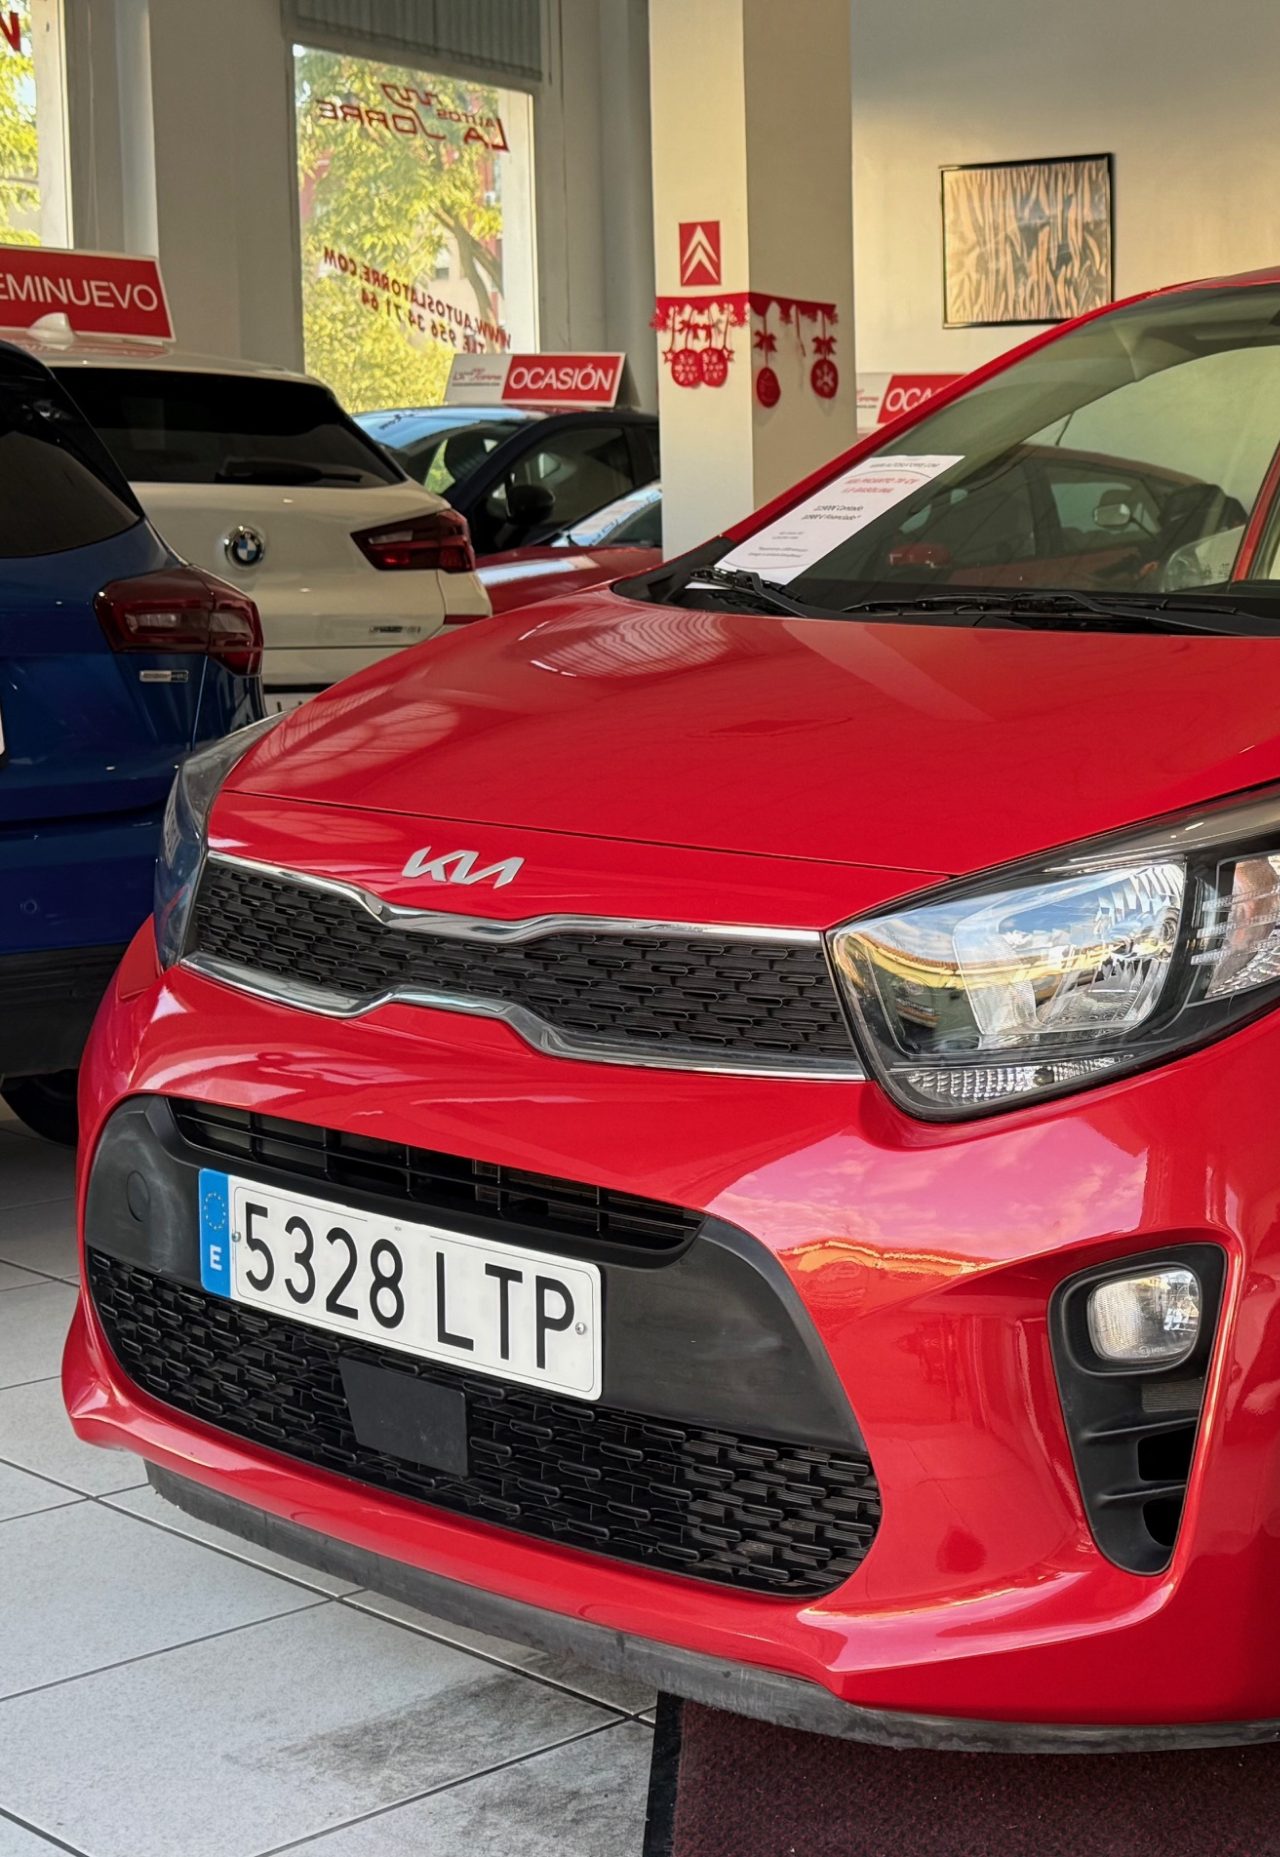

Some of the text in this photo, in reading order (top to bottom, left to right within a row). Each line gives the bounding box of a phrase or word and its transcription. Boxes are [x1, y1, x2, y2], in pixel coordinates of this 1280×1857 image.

[509, 363, 614, 391] OCASIÓN
[401, 845, 525, 890] KIA
[209, 1244, 223, 1271] E
[244, 1200, 576, 1370] 5328 LTP
